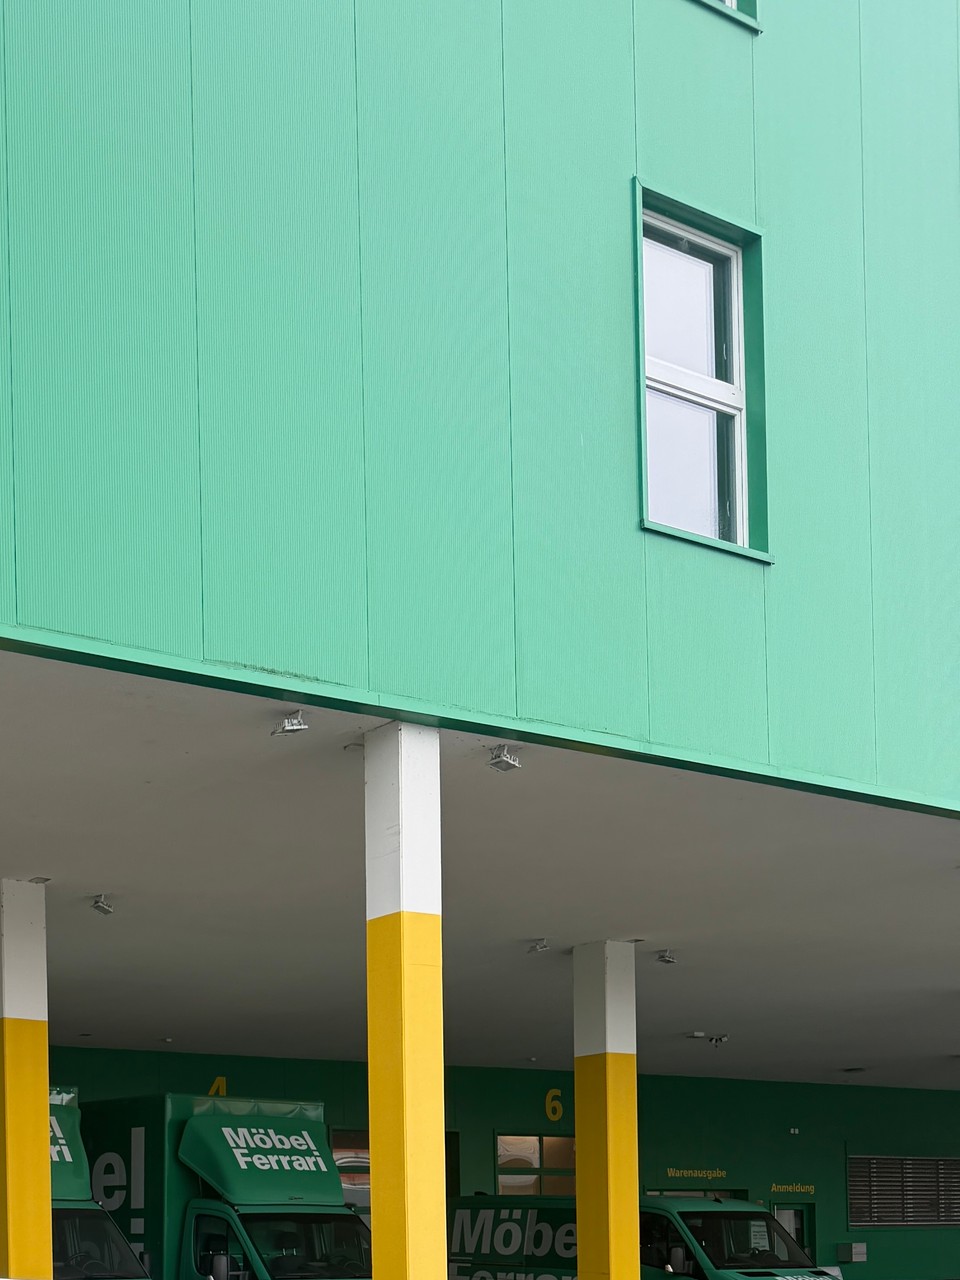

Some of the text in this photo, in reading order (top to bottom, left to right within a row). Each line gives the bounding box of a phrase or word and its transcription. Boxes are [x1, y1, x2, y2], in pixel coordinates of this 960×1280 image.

[545, 1088, 563, 1121] 6
[221, 1127, 317, 1150] Möbel
[231, 1148, 328, 1172] Ferrari
[667, 1168, 727, 1180] Warenausgabe
[771, 1183, 815, 1194] Anmeldung
[451, 1209, 577, 1258] Möbe
